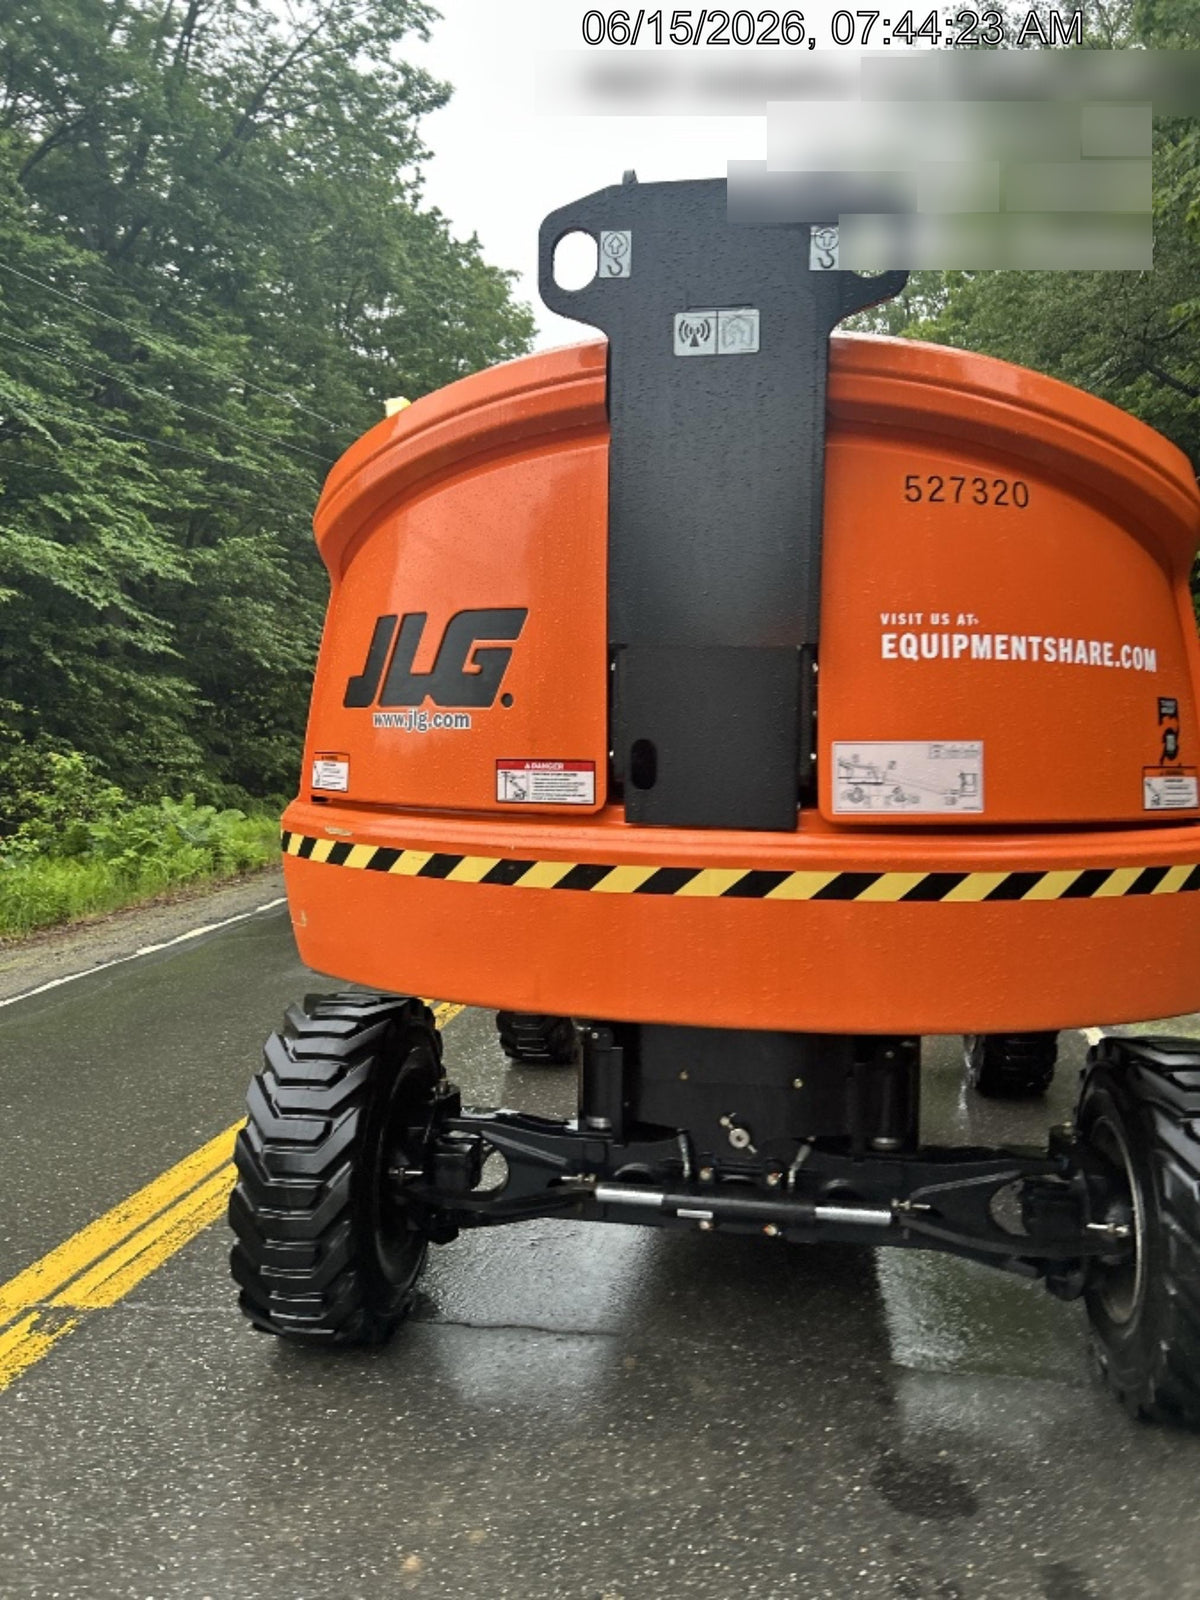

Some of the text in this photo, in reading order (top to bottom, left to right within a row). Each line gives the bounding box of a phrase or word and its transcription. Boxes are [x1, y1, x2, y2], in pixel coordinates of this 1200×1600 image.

[904, 475, 1030, 508] 527320
[880, 612, 923, 626] VISIT
[930, 612, 951, 626] US
[880, 632, 1158, 673] EQUIPMENTSHARE.COM
[373, 709, 471, 732] www.jlg.com
